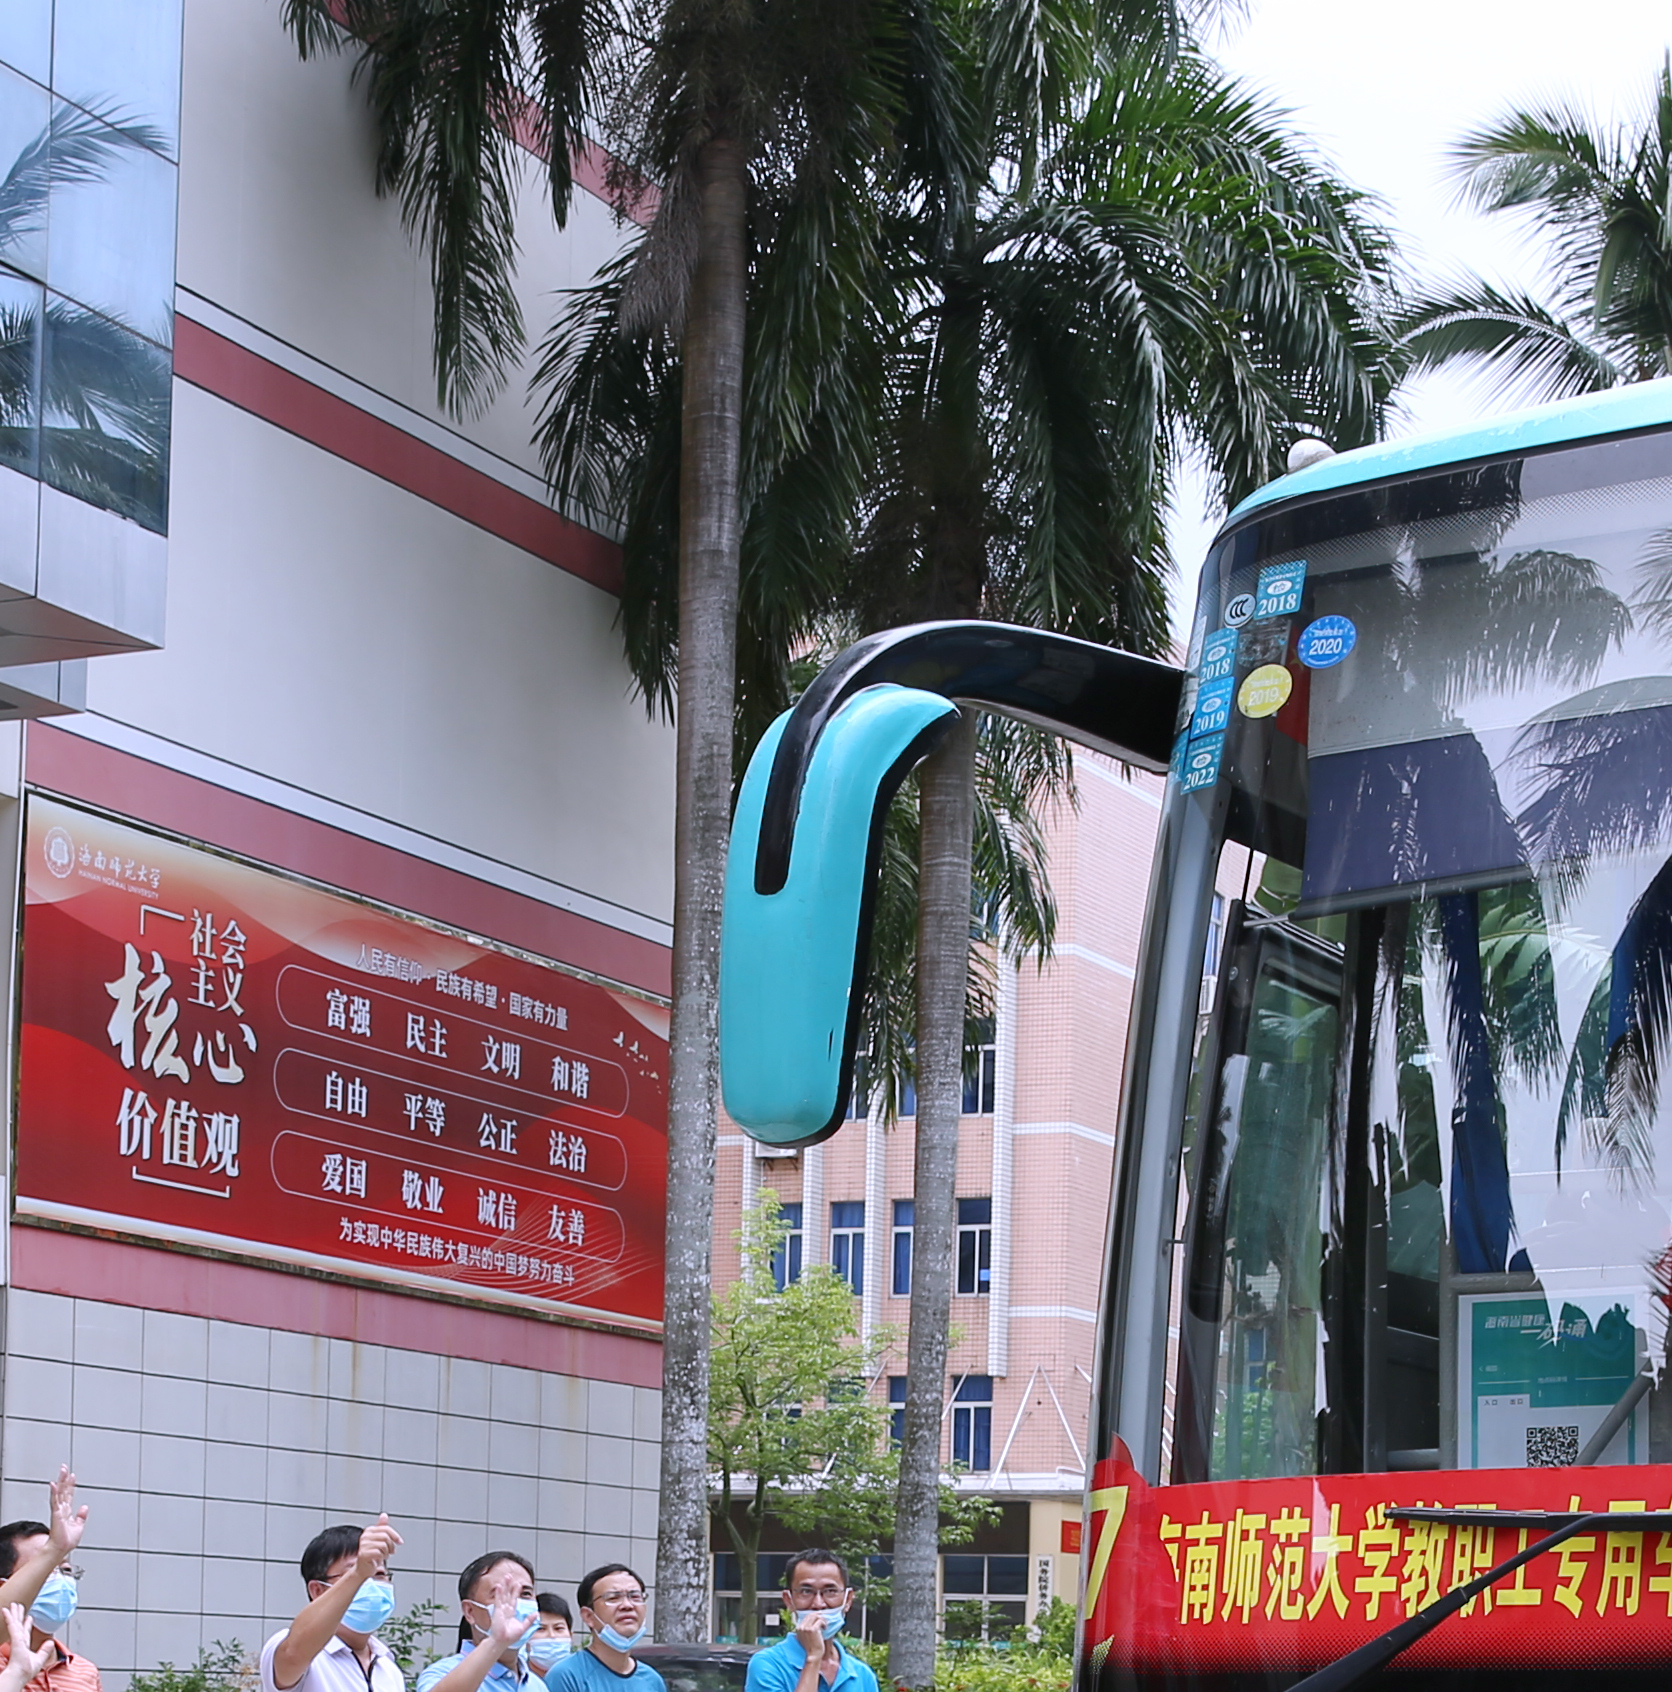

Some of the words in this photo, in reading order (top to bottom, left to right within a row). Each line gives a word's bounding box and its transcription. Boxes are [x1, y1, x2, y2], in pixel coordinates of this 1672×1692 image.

[1258, 593, 1297, 616] 2018
[1200, 657, 1231, 684] 2018
[1309, 638, 1343, 656] 2020
[1194, 710, 1225, 735] 2019
[1248, 687, 1280, 706] 2019
[1183, 767, 1215, 791] 2022
[78, 843, 160, 889] 海南师范大学
[78, 869, 102, 882] HAINAN
[102, 876, 127, 891] NORMAL
[127, 884, 159, 900] UNIVERSITY
[189, 907, 247, 969] 社会
[104, 942, 258, 1084] 核心
[187, 958, 245, 1017] 主义
[326, 988, 373, 1038] 富强
[405, 1011, 448, 1059] 民主
[480, 1034, 522, 1081] 文明
[550, 1055, 590, 1100] 和谐
[115, 1087, 240, 1178] 价值观
[324, 1070, 368, 1118] 自由
[403, 1092, 446, 1138] 平等
[477, 1112, 518, 1156] 公正
[549, 1129, 588, 1173] 法治
[321, 1153, 368, 1199] 爱国
[401, 1168, 445, 1214] 敬业
[477, 1187, 518, 1232] 诚信
[547, 1204, 586, 1247] 友善
[339, 1216, 576, 1288] 为实现中华民族伟大复兴的中国梦努力奋斗
[1085, 1486, 1128, 1620] 7
